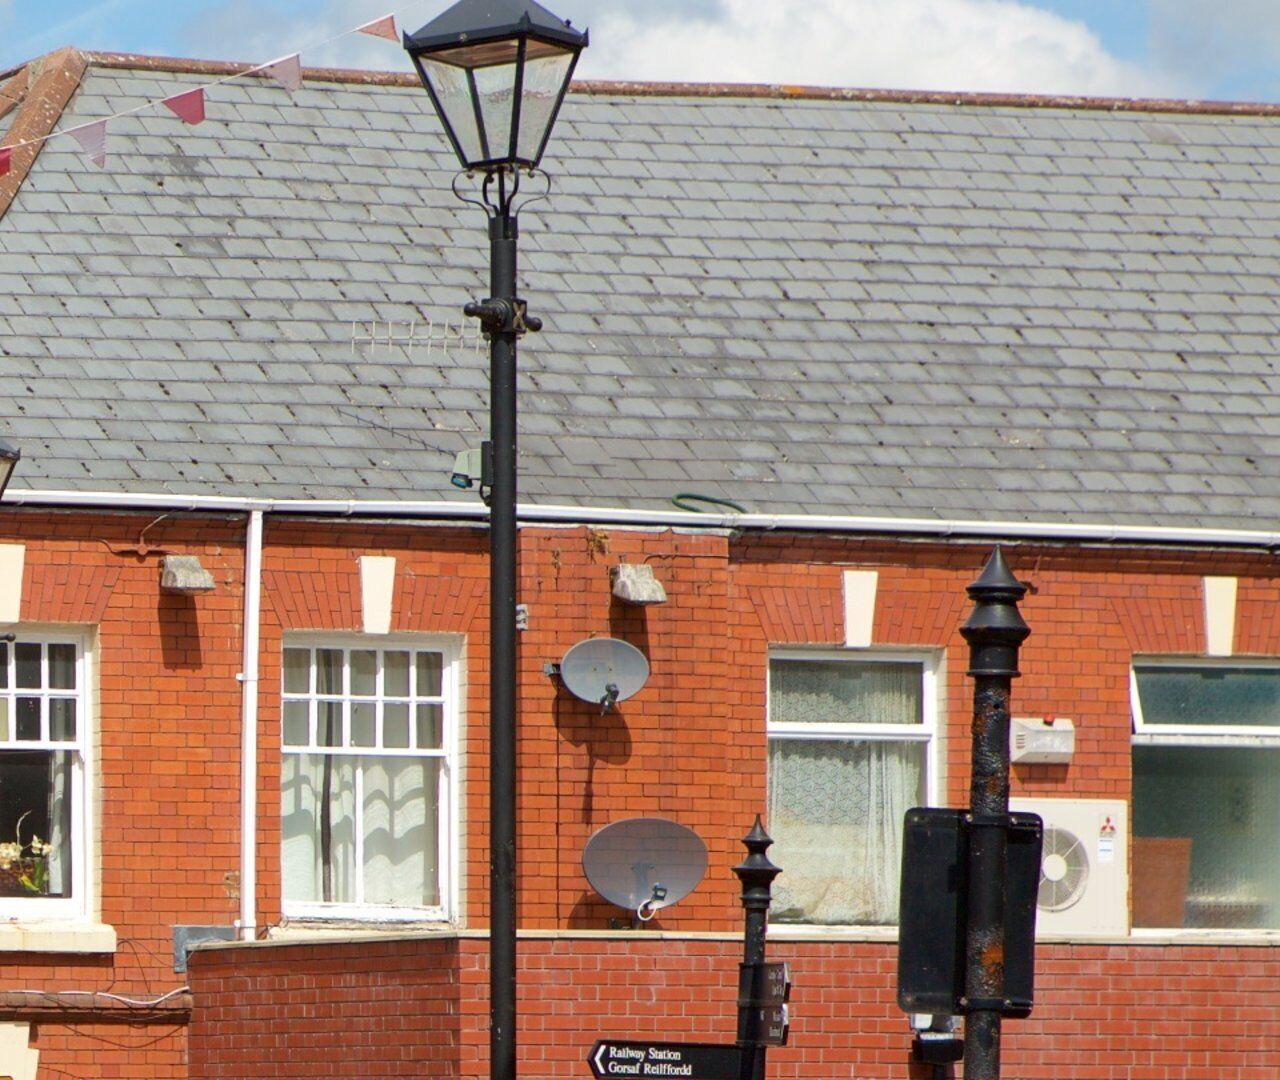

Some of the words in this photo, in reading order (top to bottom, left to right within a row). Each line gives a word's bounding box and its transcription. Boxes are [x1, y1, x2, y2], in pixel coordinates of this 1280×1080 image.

[609, 1046, 646, 1061] Railway
[648, 1047, 681, 1060] Station
[608, 1061, 640, 1074] Gorsaf
[643, 1063, 692, 1075] Reilffordd
